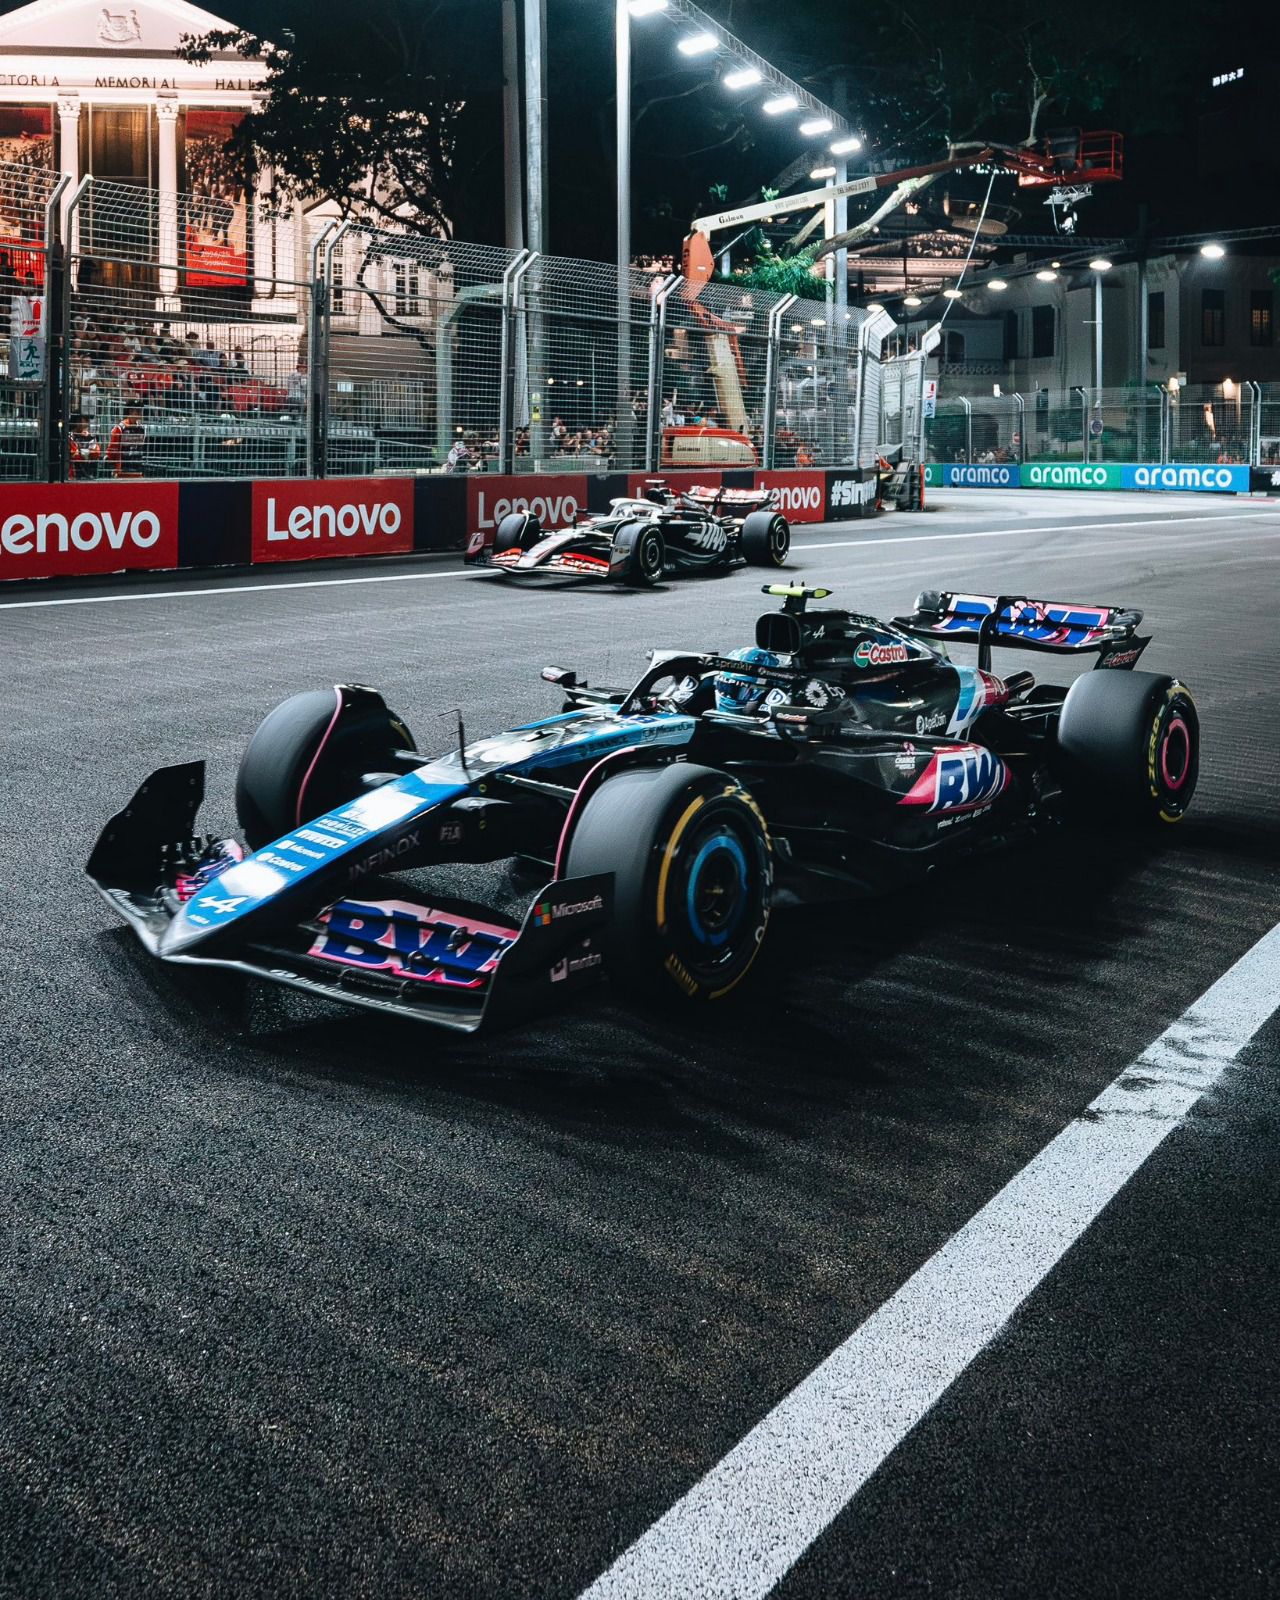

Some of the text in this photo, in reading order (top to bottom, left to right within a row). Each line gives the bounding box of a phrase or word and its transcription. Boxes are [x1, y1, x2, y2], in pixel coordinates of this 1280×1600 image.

[95, 77, 179, 89] MEMORIAL
[215, 79, 256, 91] HALL
[951, 466, 1010, 484] aramco
[1030, 467, 1107, 485] aramco
[1135, 467, 1233, 488] aramco
[267, 498, 401, 541] Lenovo
[0, 510, 161, 555] enovo
[869, 642, 908, 664] Castrol
[825, 684, 846, 699] bp
[350, 831, 421, 879] INFINOX
[552, 896, 603, 920] Microsoft
